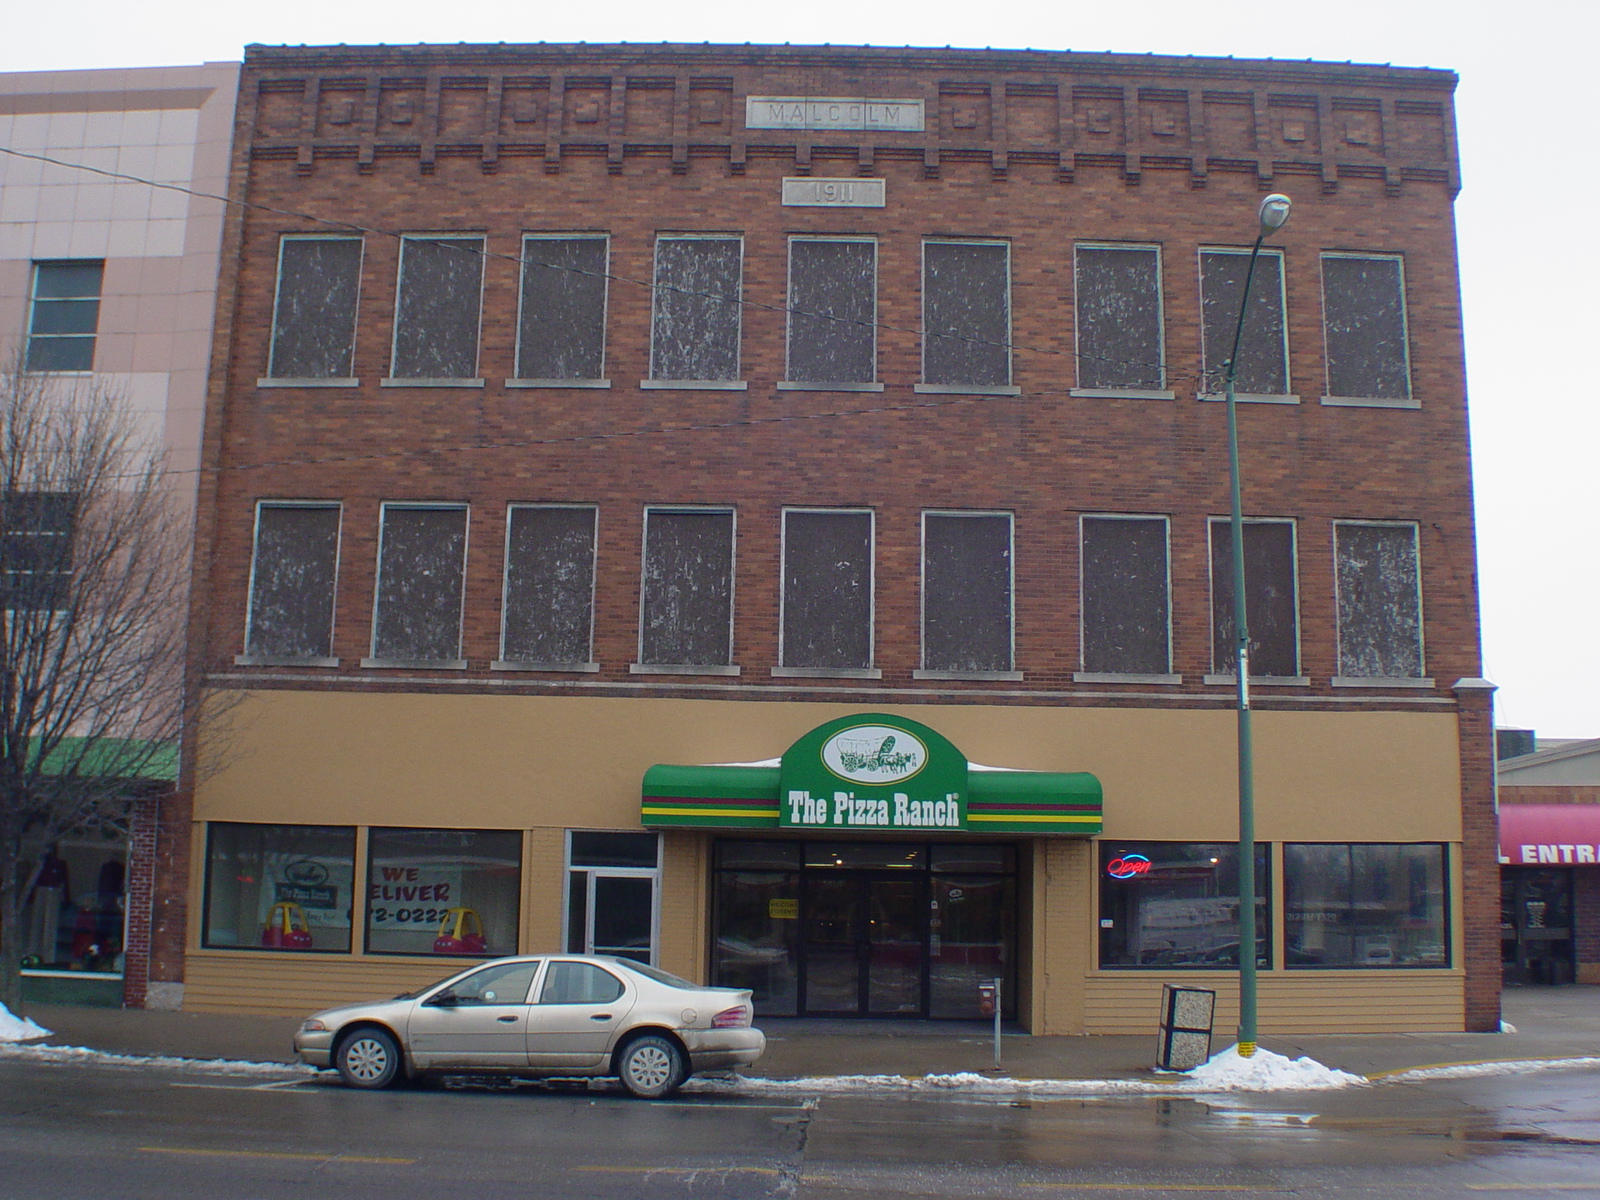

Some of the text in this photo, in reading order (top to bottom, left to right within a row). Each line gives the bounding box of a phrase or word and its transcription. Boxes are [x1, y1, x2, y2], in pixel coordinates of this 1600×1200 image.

[768, 103, 900, 121] MALCOLM
[814, 184, 855, 202] 1911
[788, 790, 828, 824] The
[833, 791, 889, 826] Pizza
[1521, 844, 1600, 864] ENTR
[382, 867, 418, 882] WE
[1108, 858, 1152, 875] Open
[371, 883, 450, 902] ELIVER
